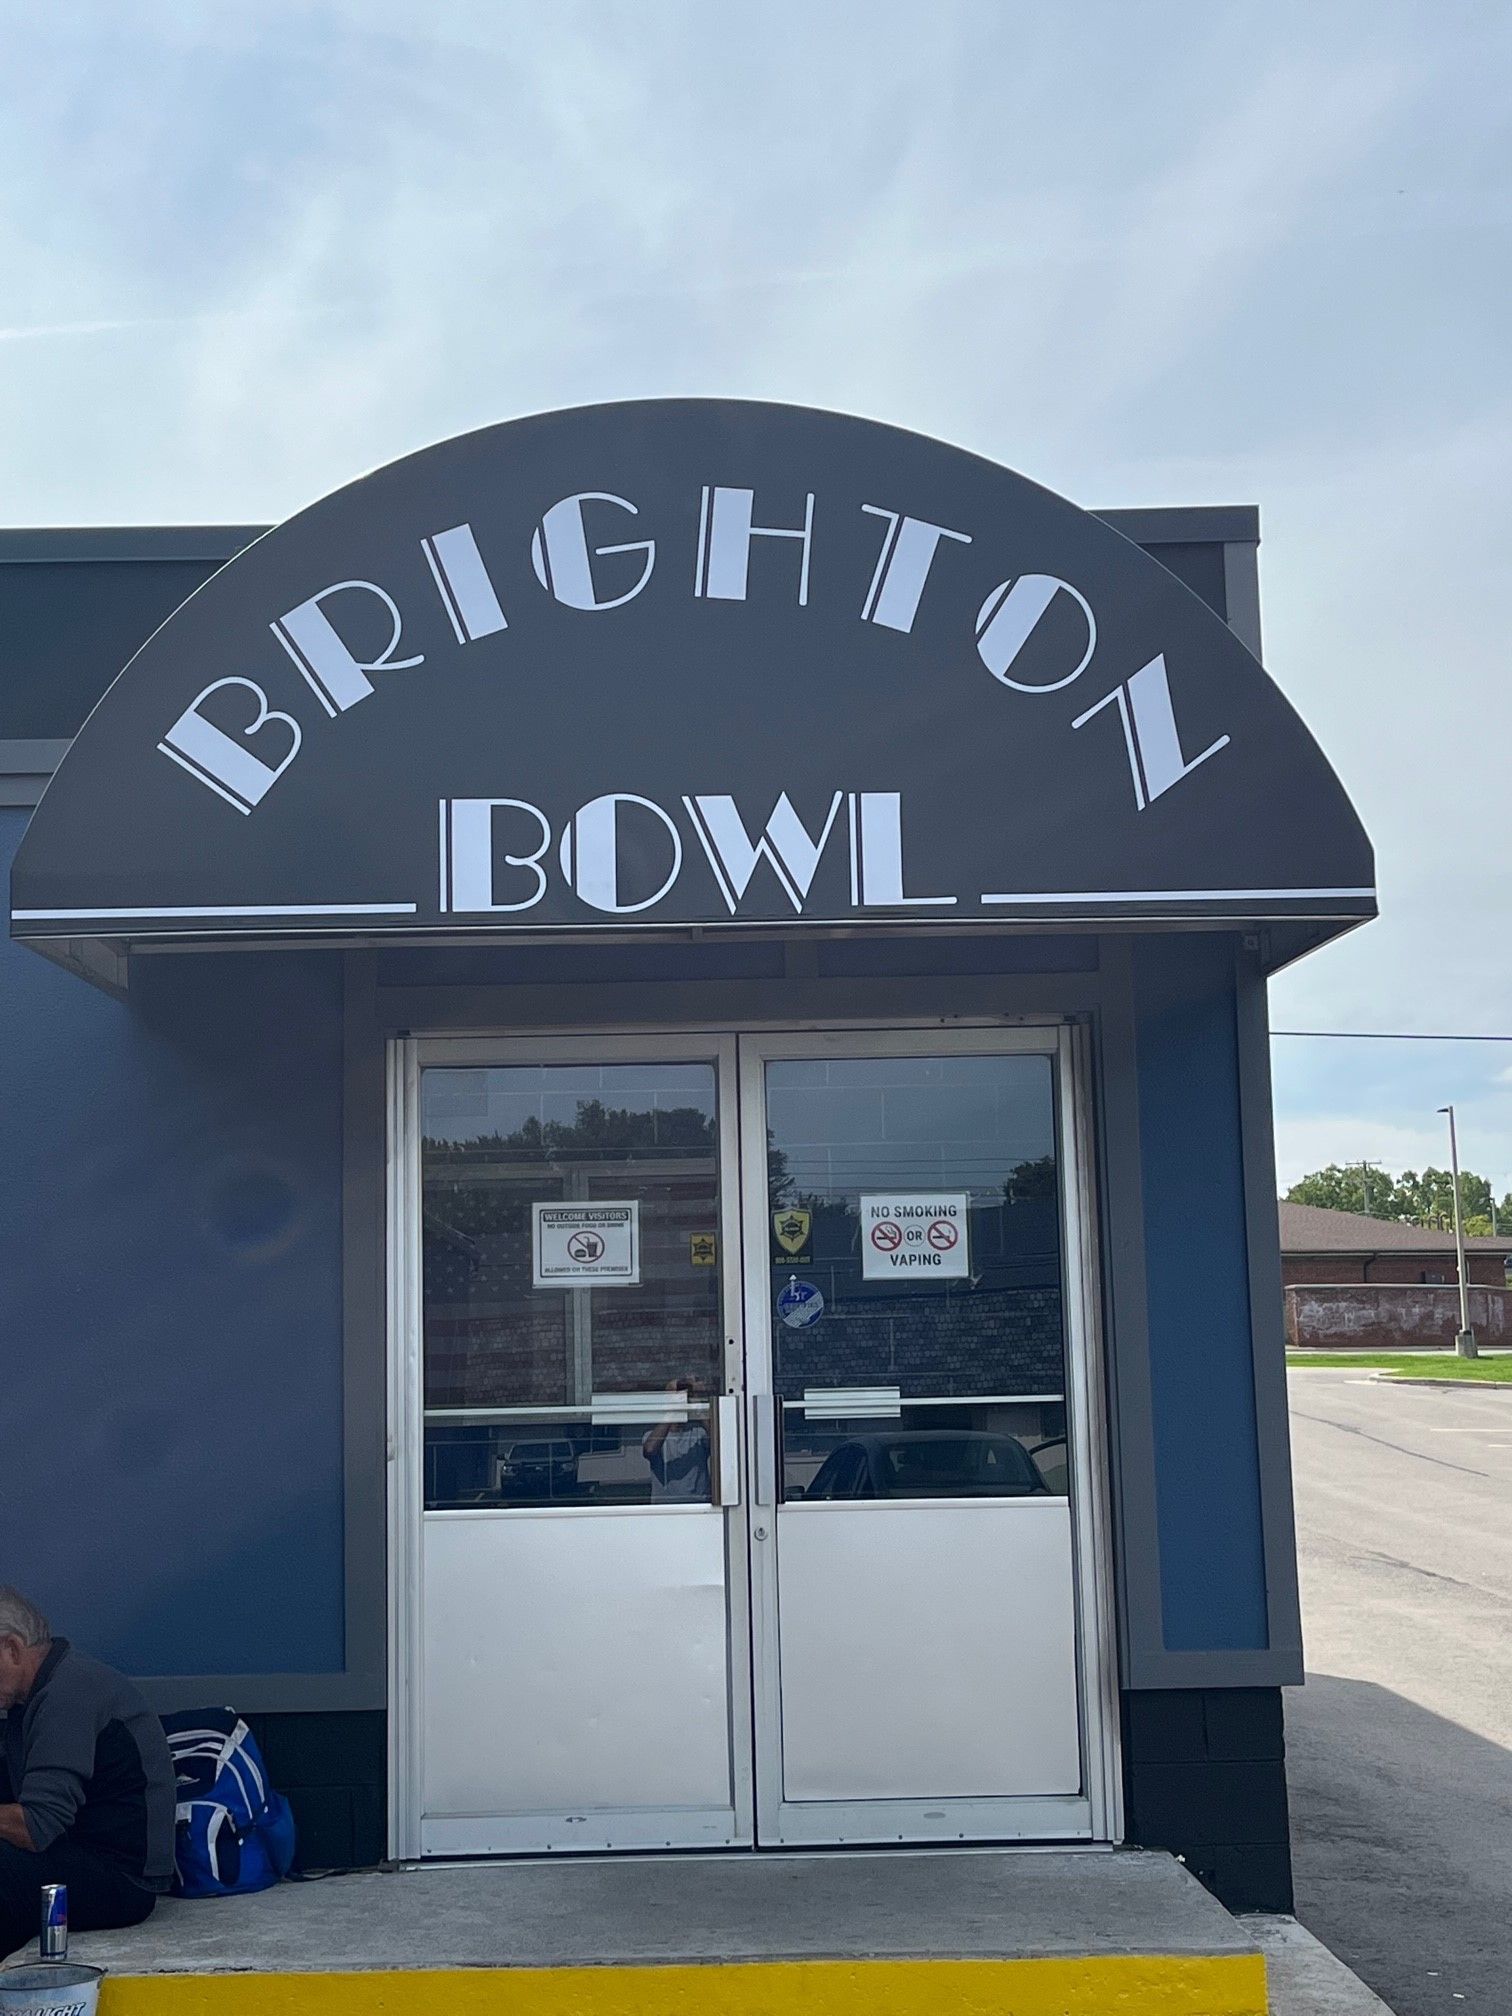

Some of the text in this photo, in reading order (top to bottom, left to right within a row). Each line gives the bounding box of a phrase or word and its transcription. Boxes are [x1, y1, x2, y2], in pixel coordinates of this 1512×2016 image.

[157, 486, 1230, 814] BRIGHTON
[439, 790, 958, 915] BOWL
[544, 1211, 628, 1221] WELCOME VISITORS
[871, 1205, 957, 1218] NO SMOKING
[906, 1230, 923, 1241] OR
[890, 1253, 942, 1267] VAPING
